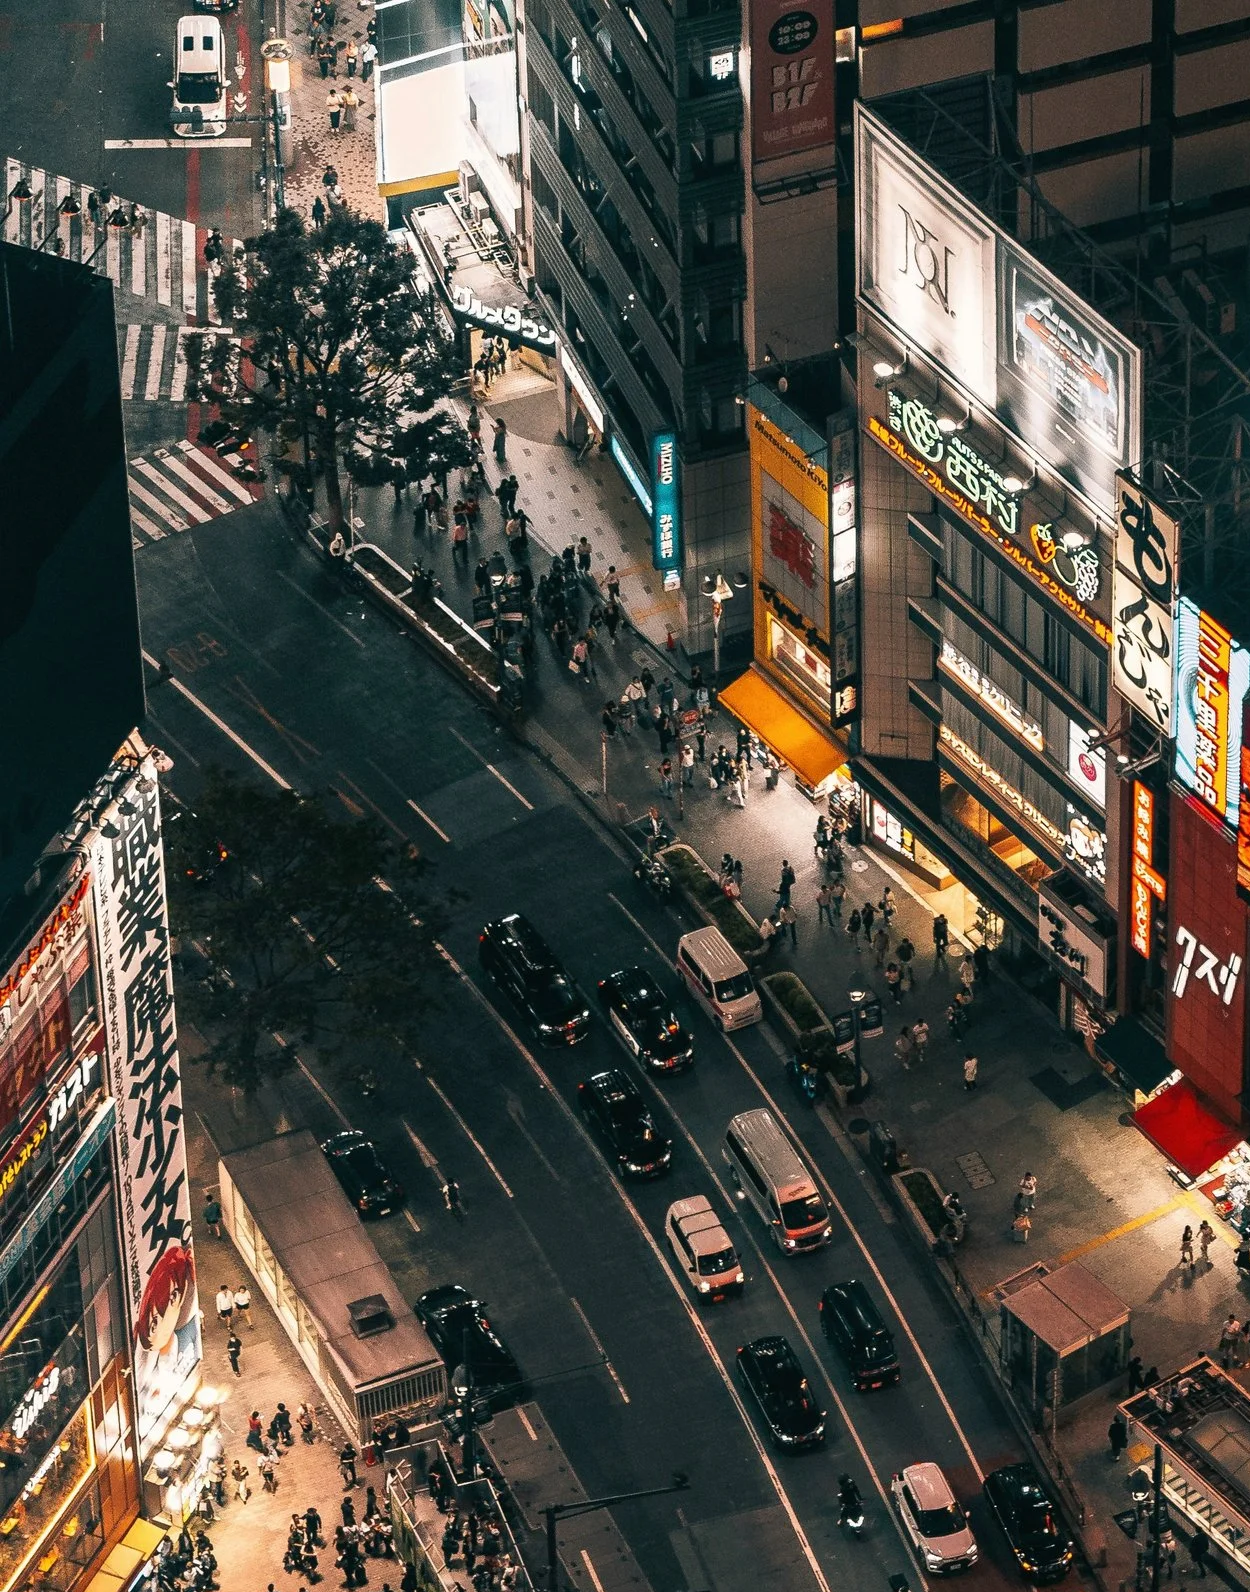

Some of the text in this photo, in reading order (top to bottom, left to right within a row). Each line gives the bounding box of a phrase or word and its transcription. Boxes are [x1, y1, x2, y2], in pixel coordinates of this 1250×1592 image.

[772, 57, 817, 88] B1F
[772, 82, 819, 113] B2F
[658, 442, 674, 485] MIZUHO
[754, 420, 807, 473] Matsumoto
[945, 445, 1019, 535] 西村
[1193, 624, 1230, 808] 三千里薬品
[48, 1053, 98, 1133] ガスト
